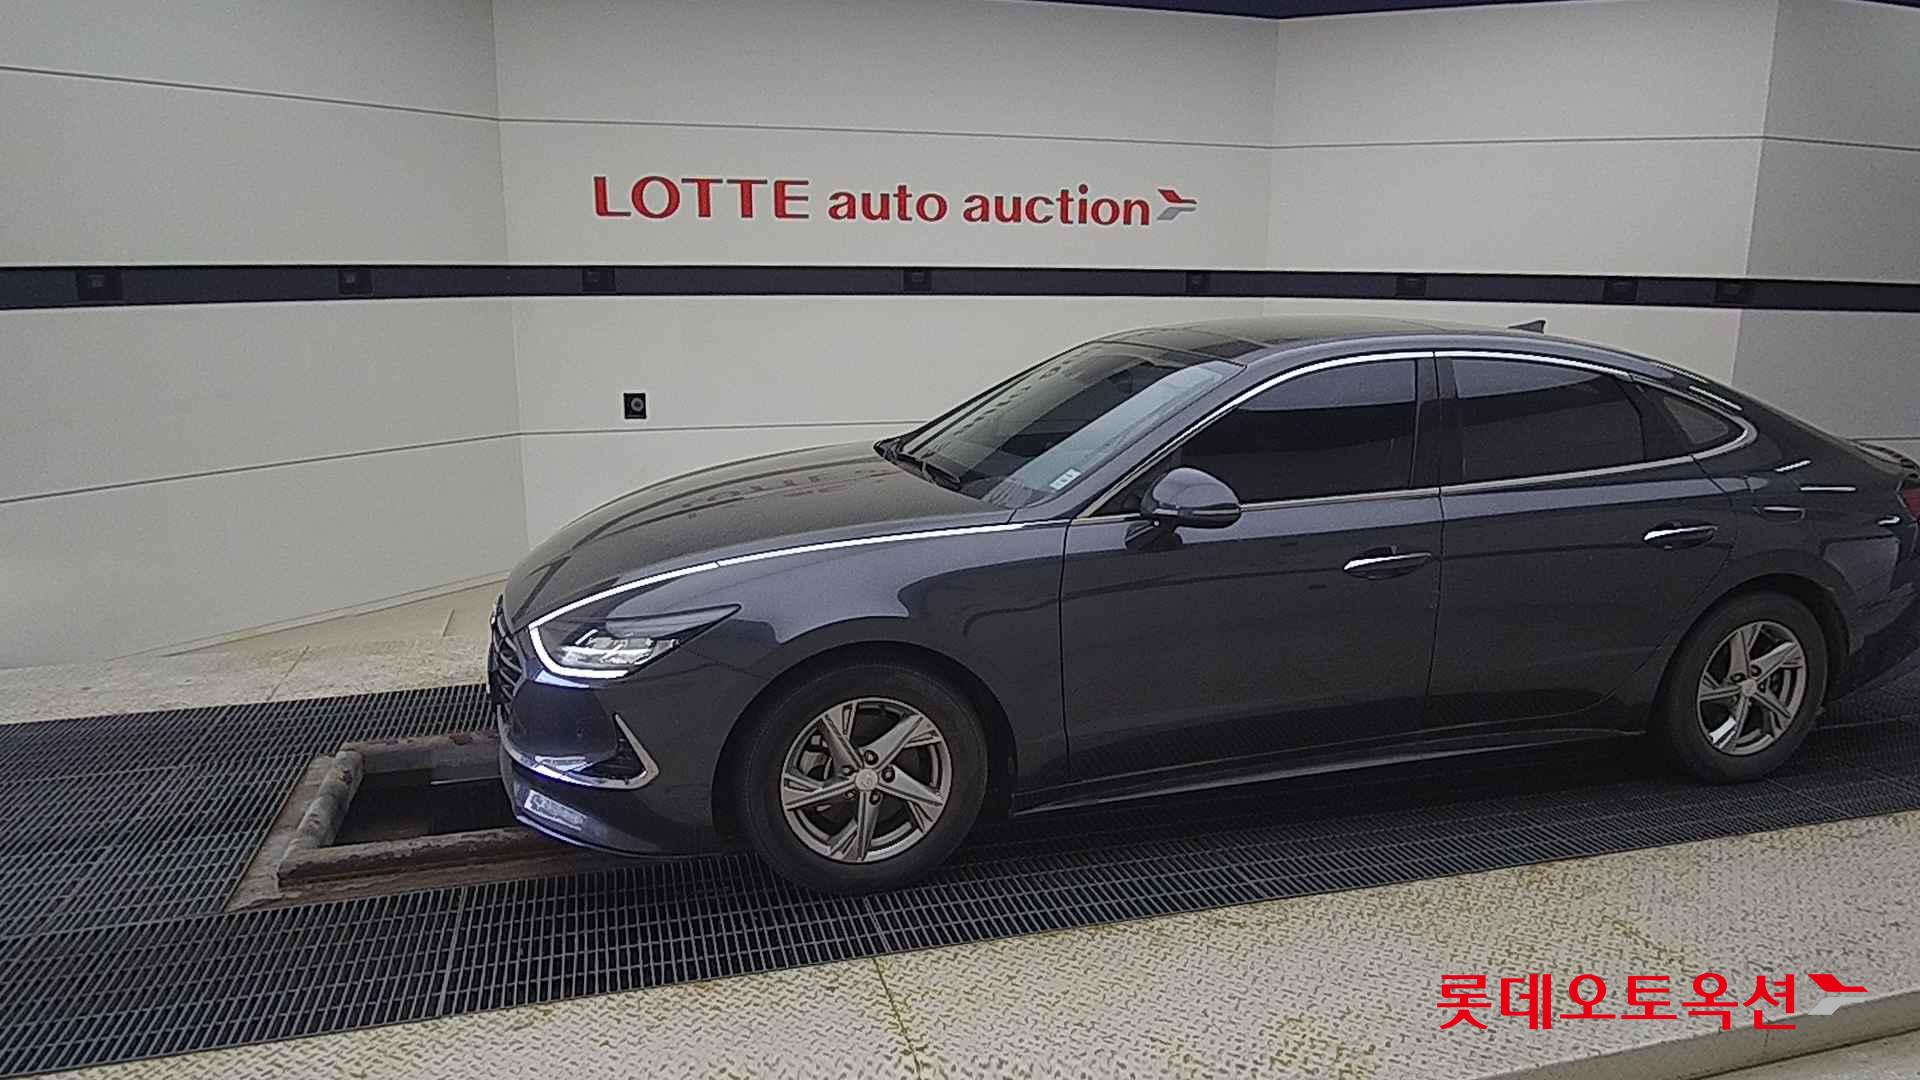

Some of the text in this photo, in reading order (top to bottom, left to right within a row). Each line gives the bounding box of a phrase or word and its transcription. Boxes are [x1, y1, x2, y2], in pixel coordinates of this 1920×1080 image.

[593, 176, 1151, 226] LOTTE auto auction
